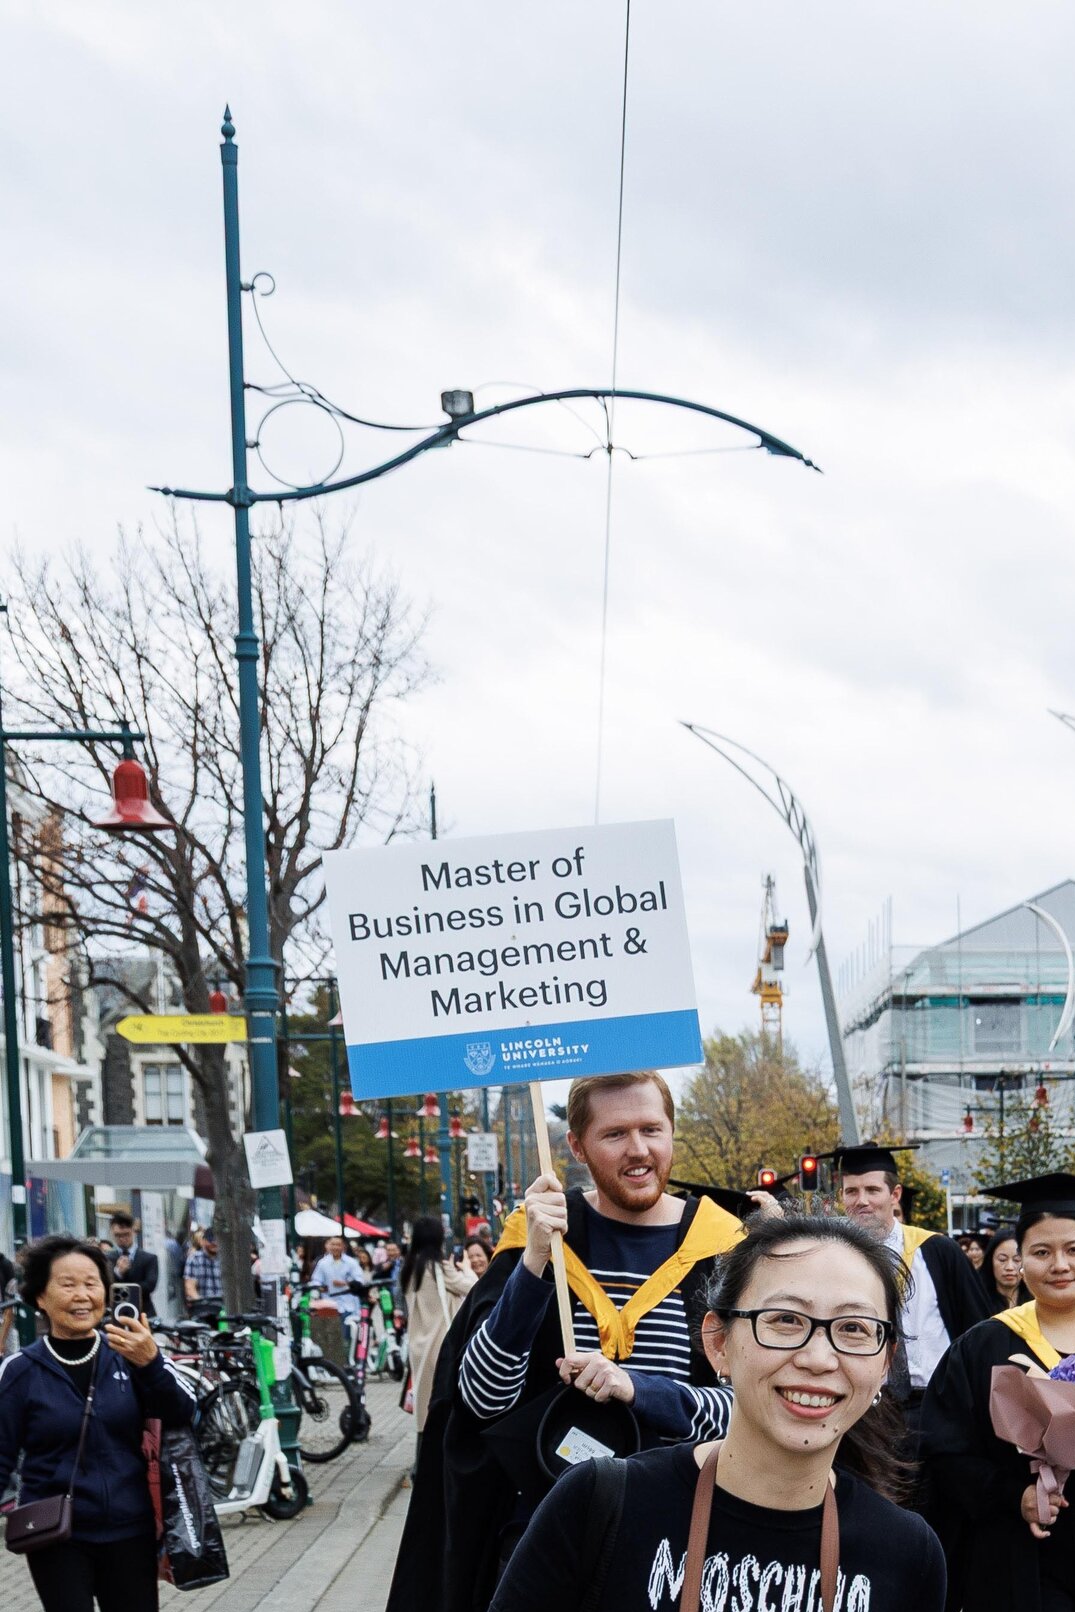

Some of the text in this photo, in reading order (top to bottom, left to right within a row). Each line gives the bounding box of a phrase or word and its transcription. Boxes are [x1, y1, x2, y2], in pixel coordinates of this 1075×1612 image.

[421, 847, 585, 891] Master of
[349, 881, 668, 941] Business in Global
[380, 928, 648, 980] Management &
[431, 976, 608, 1017] Marketing
[501, 1037, 561, 1052] LINCOLN
[502, 1045, 589, 1062] UNIVERSITY
